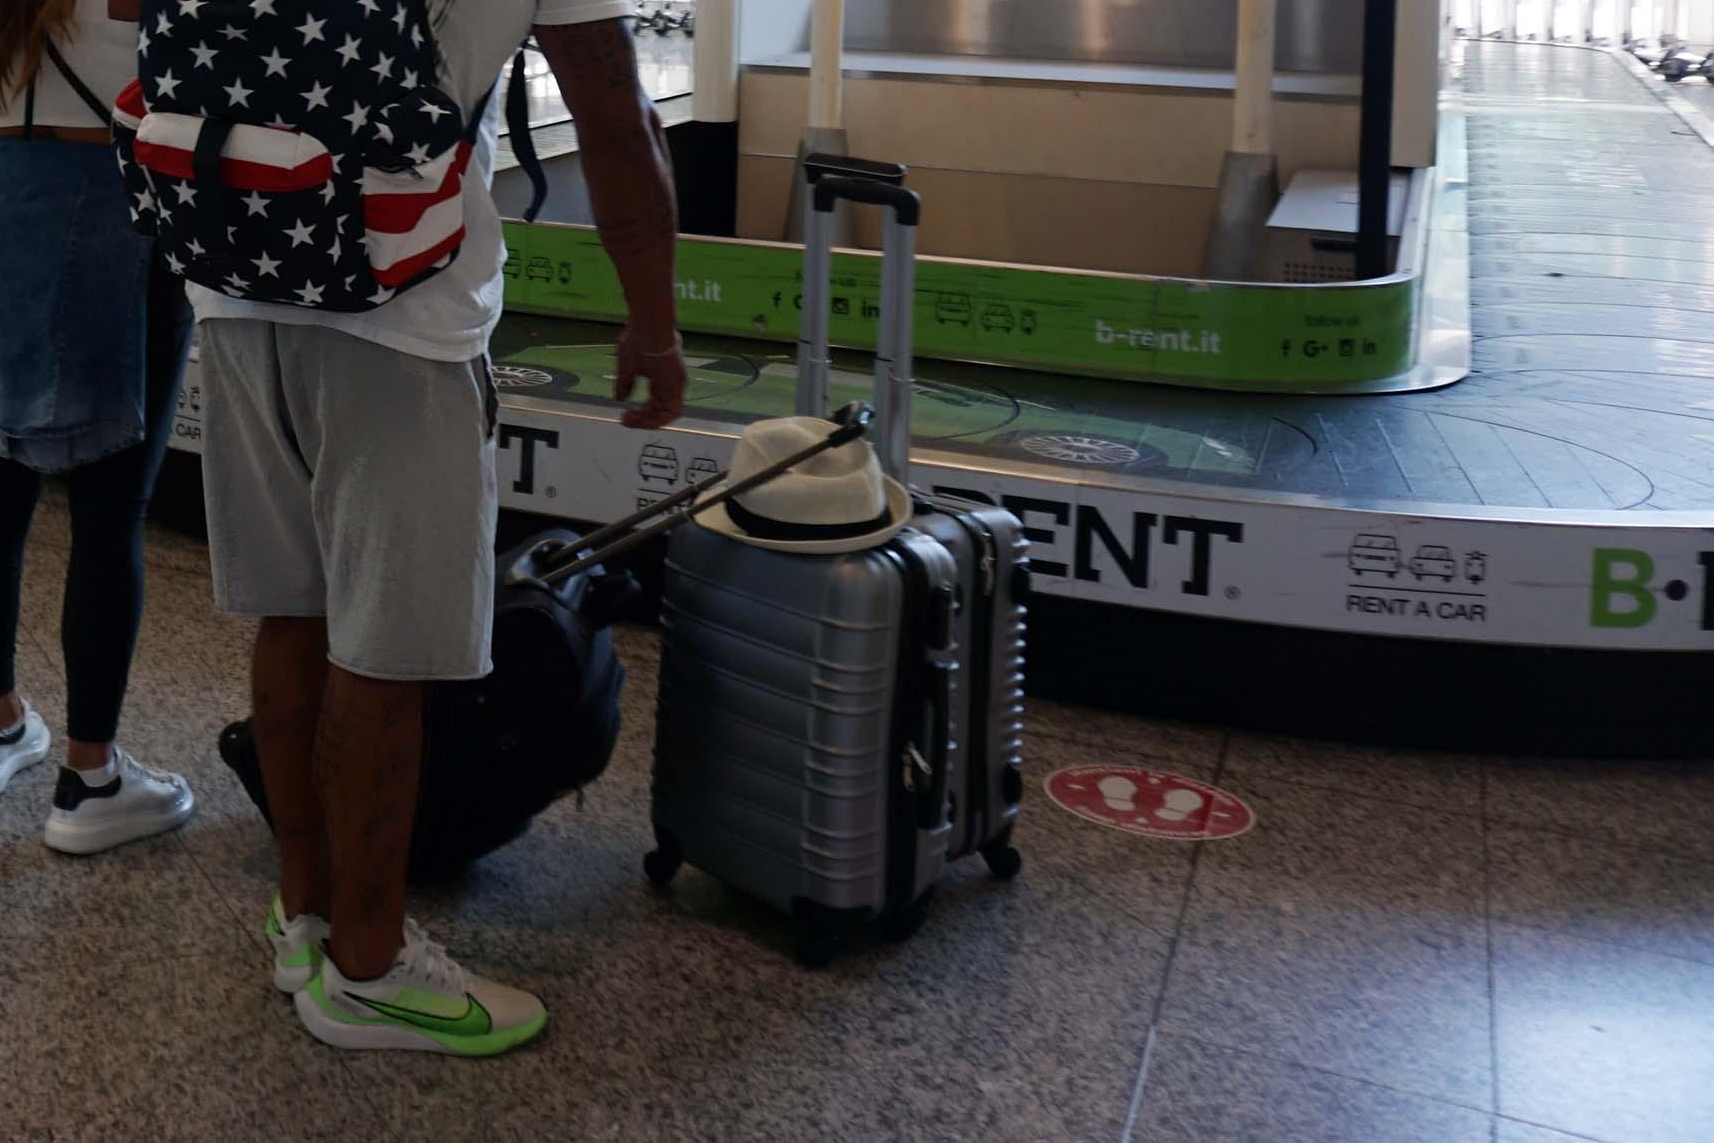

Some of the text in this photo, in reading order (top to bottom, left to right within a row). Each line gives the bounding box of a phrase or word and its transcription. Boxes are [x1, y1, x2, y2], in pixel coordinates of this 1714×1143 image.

[1094, 318, 1222, 355] b-rent.it
[1346, 594, 1487, 622] RENT A CAR
